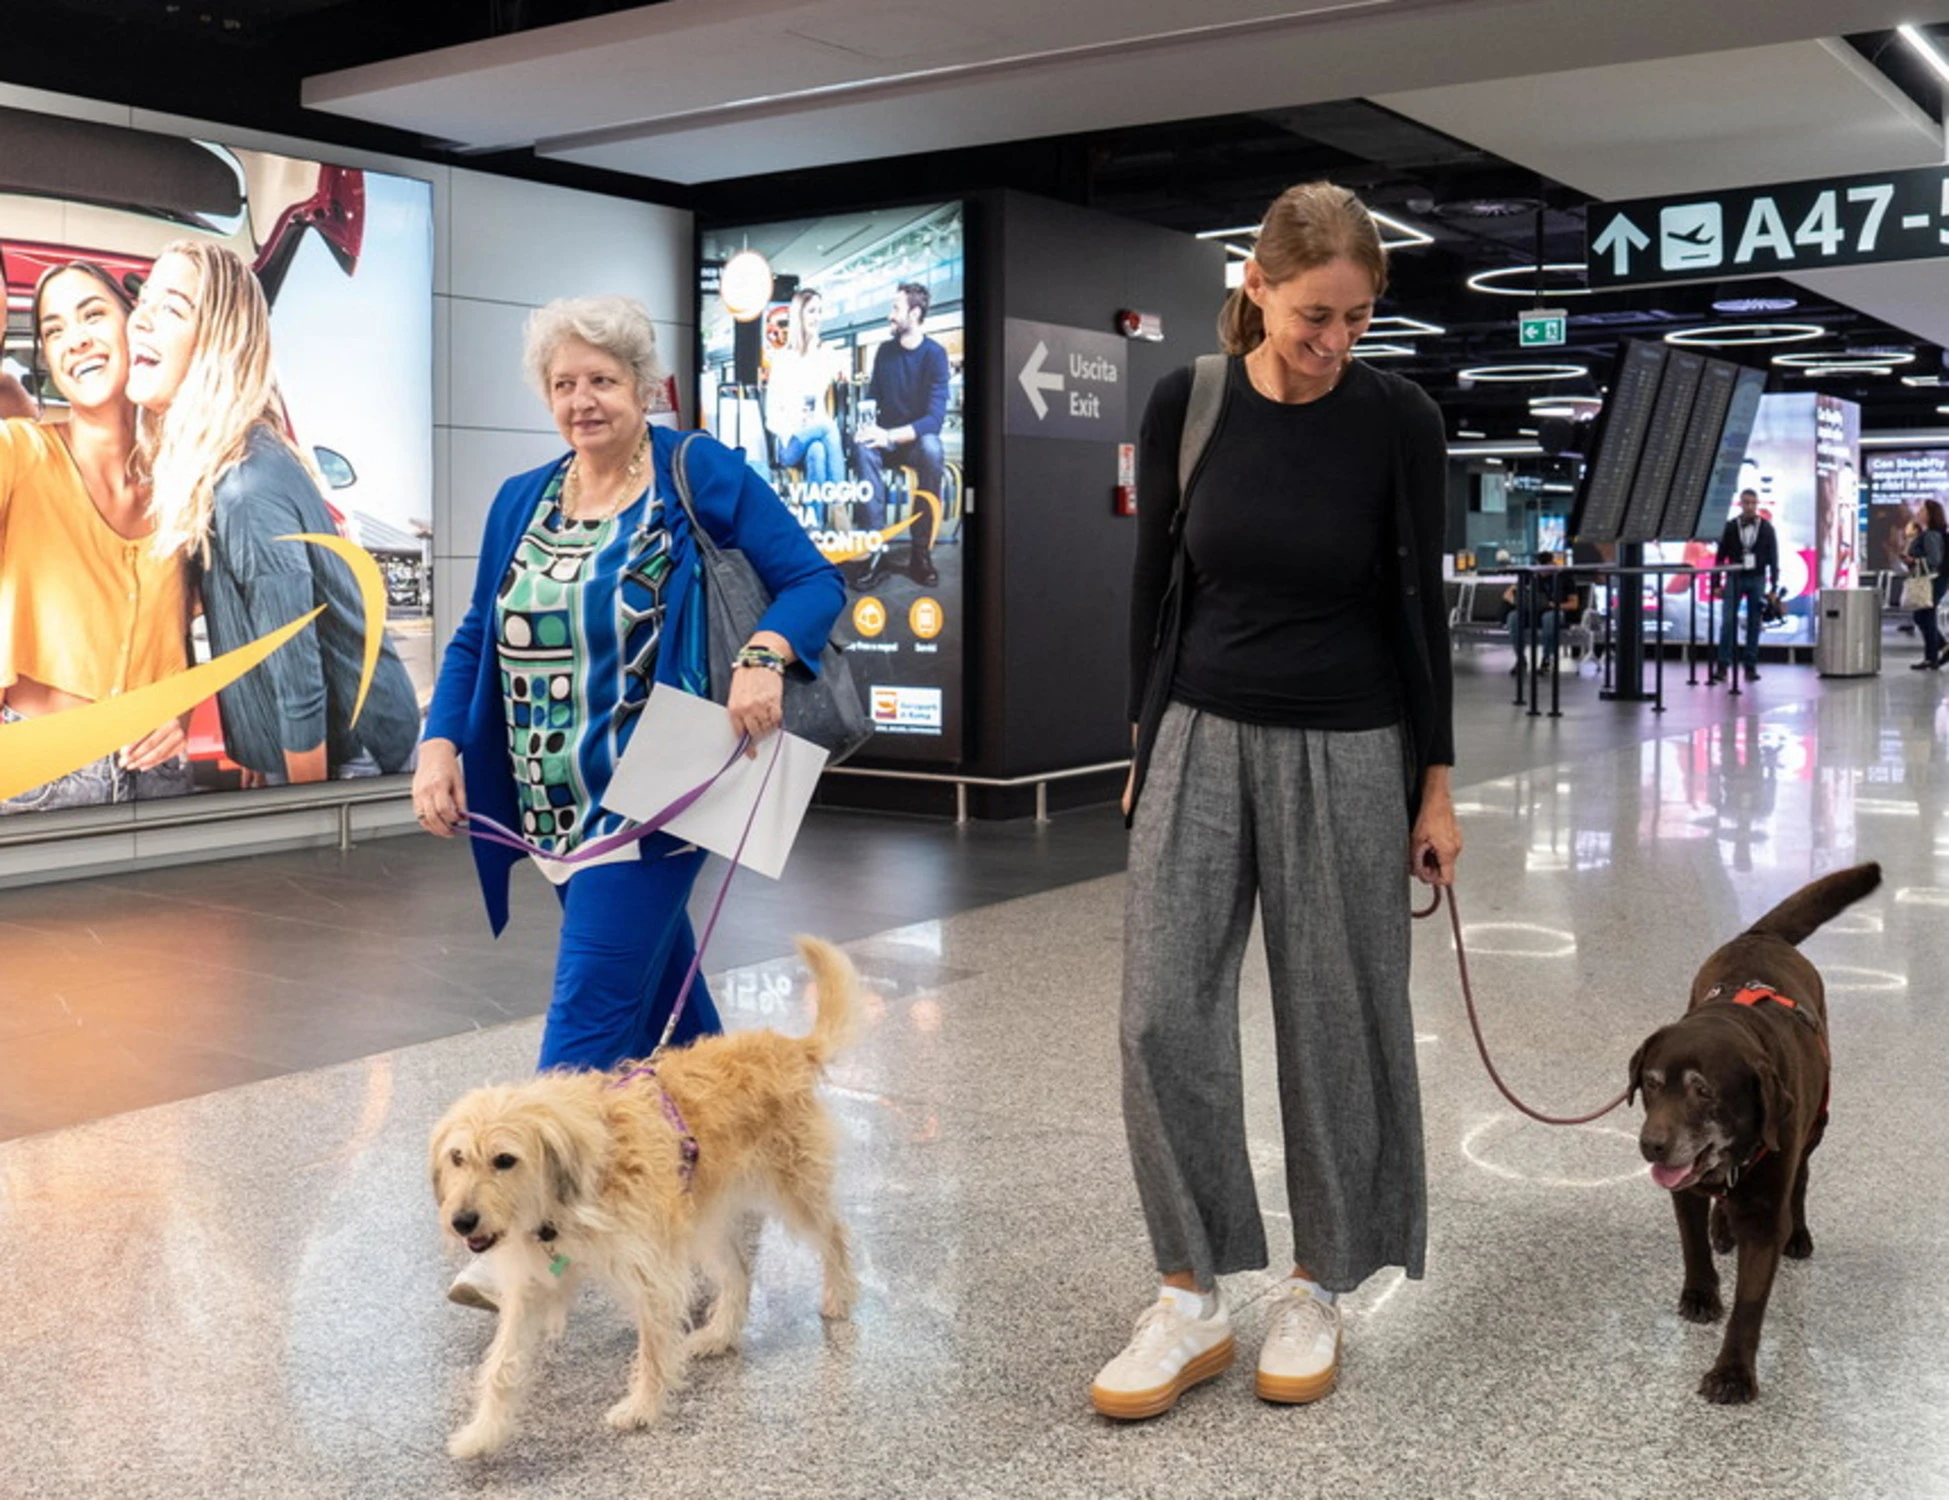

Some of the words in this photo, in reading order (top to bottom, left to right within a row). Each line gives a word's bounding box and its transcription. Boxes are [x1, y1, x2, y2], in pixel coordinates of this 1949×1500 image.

[1733, 178, 1949, 264] A47-
[1069, 353, 1118, 382] Uscita
[1069, 391, 1100, 419] Exit
[789, 481, 874, 503] VIAGGIO
